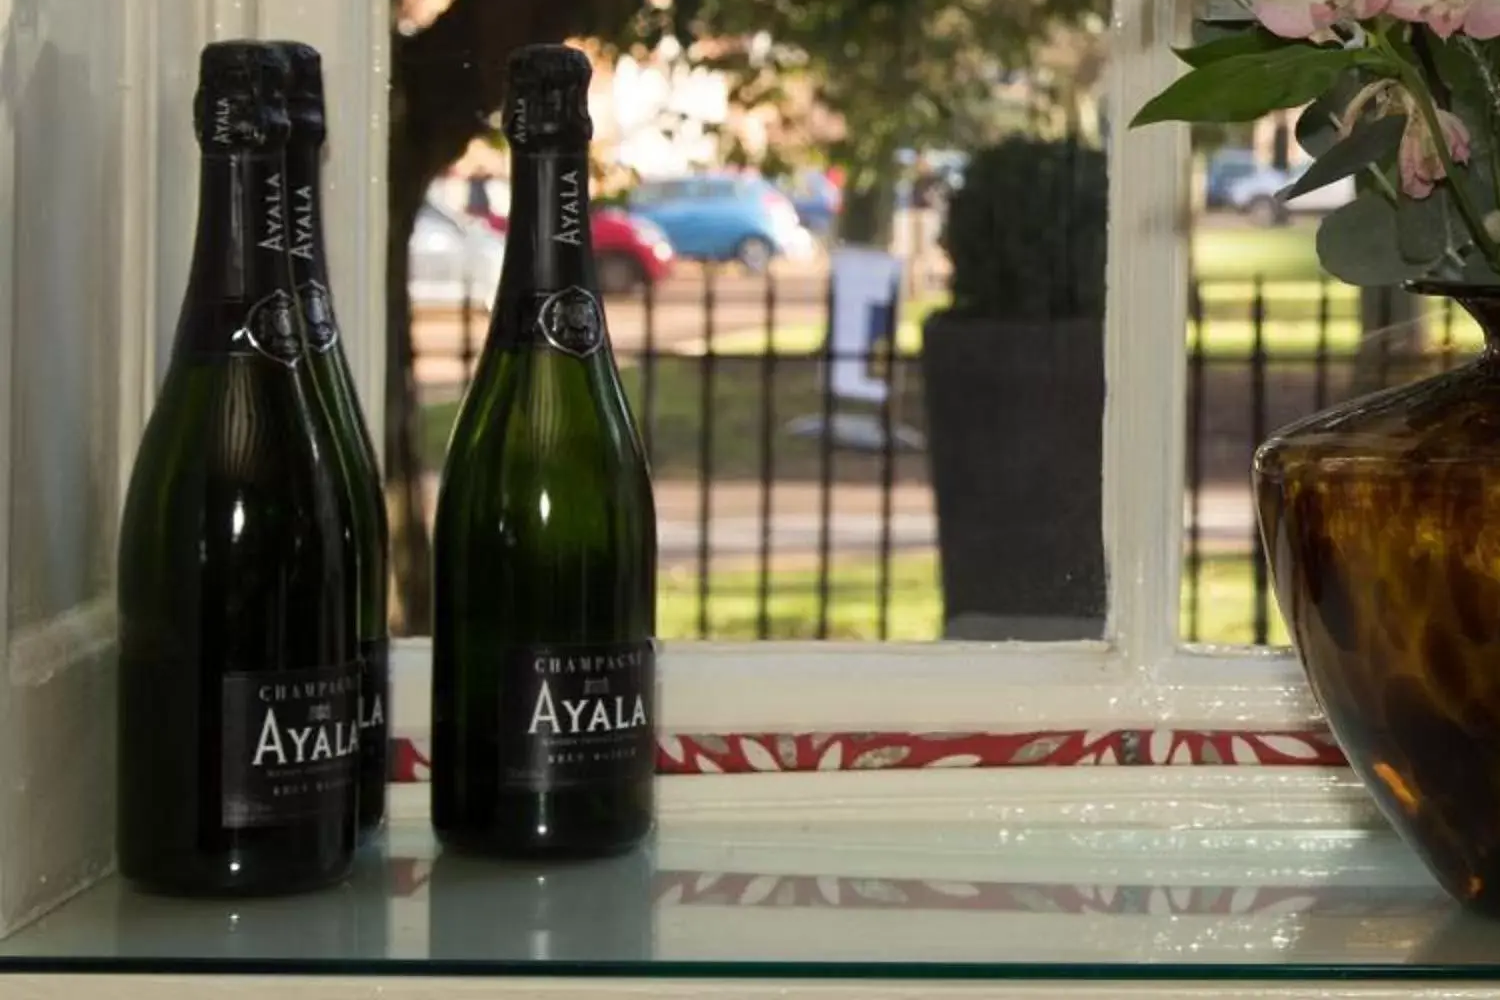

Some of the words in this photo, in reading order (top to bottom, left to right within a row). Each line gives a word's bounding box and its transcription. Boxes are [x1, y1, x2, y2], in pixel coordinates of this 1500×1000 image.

[211, 97, 233, 145] AYALA
[257, 172, 285, 252] AYALA
[289, 184, 314, 261] AYALA
[552, 170, 580, 246] AYALA
[258, 676, 352, 702] CHAMPAG
[529, 679, 648, 735] AYALA
[250, 706, 361, 767] AYALA
